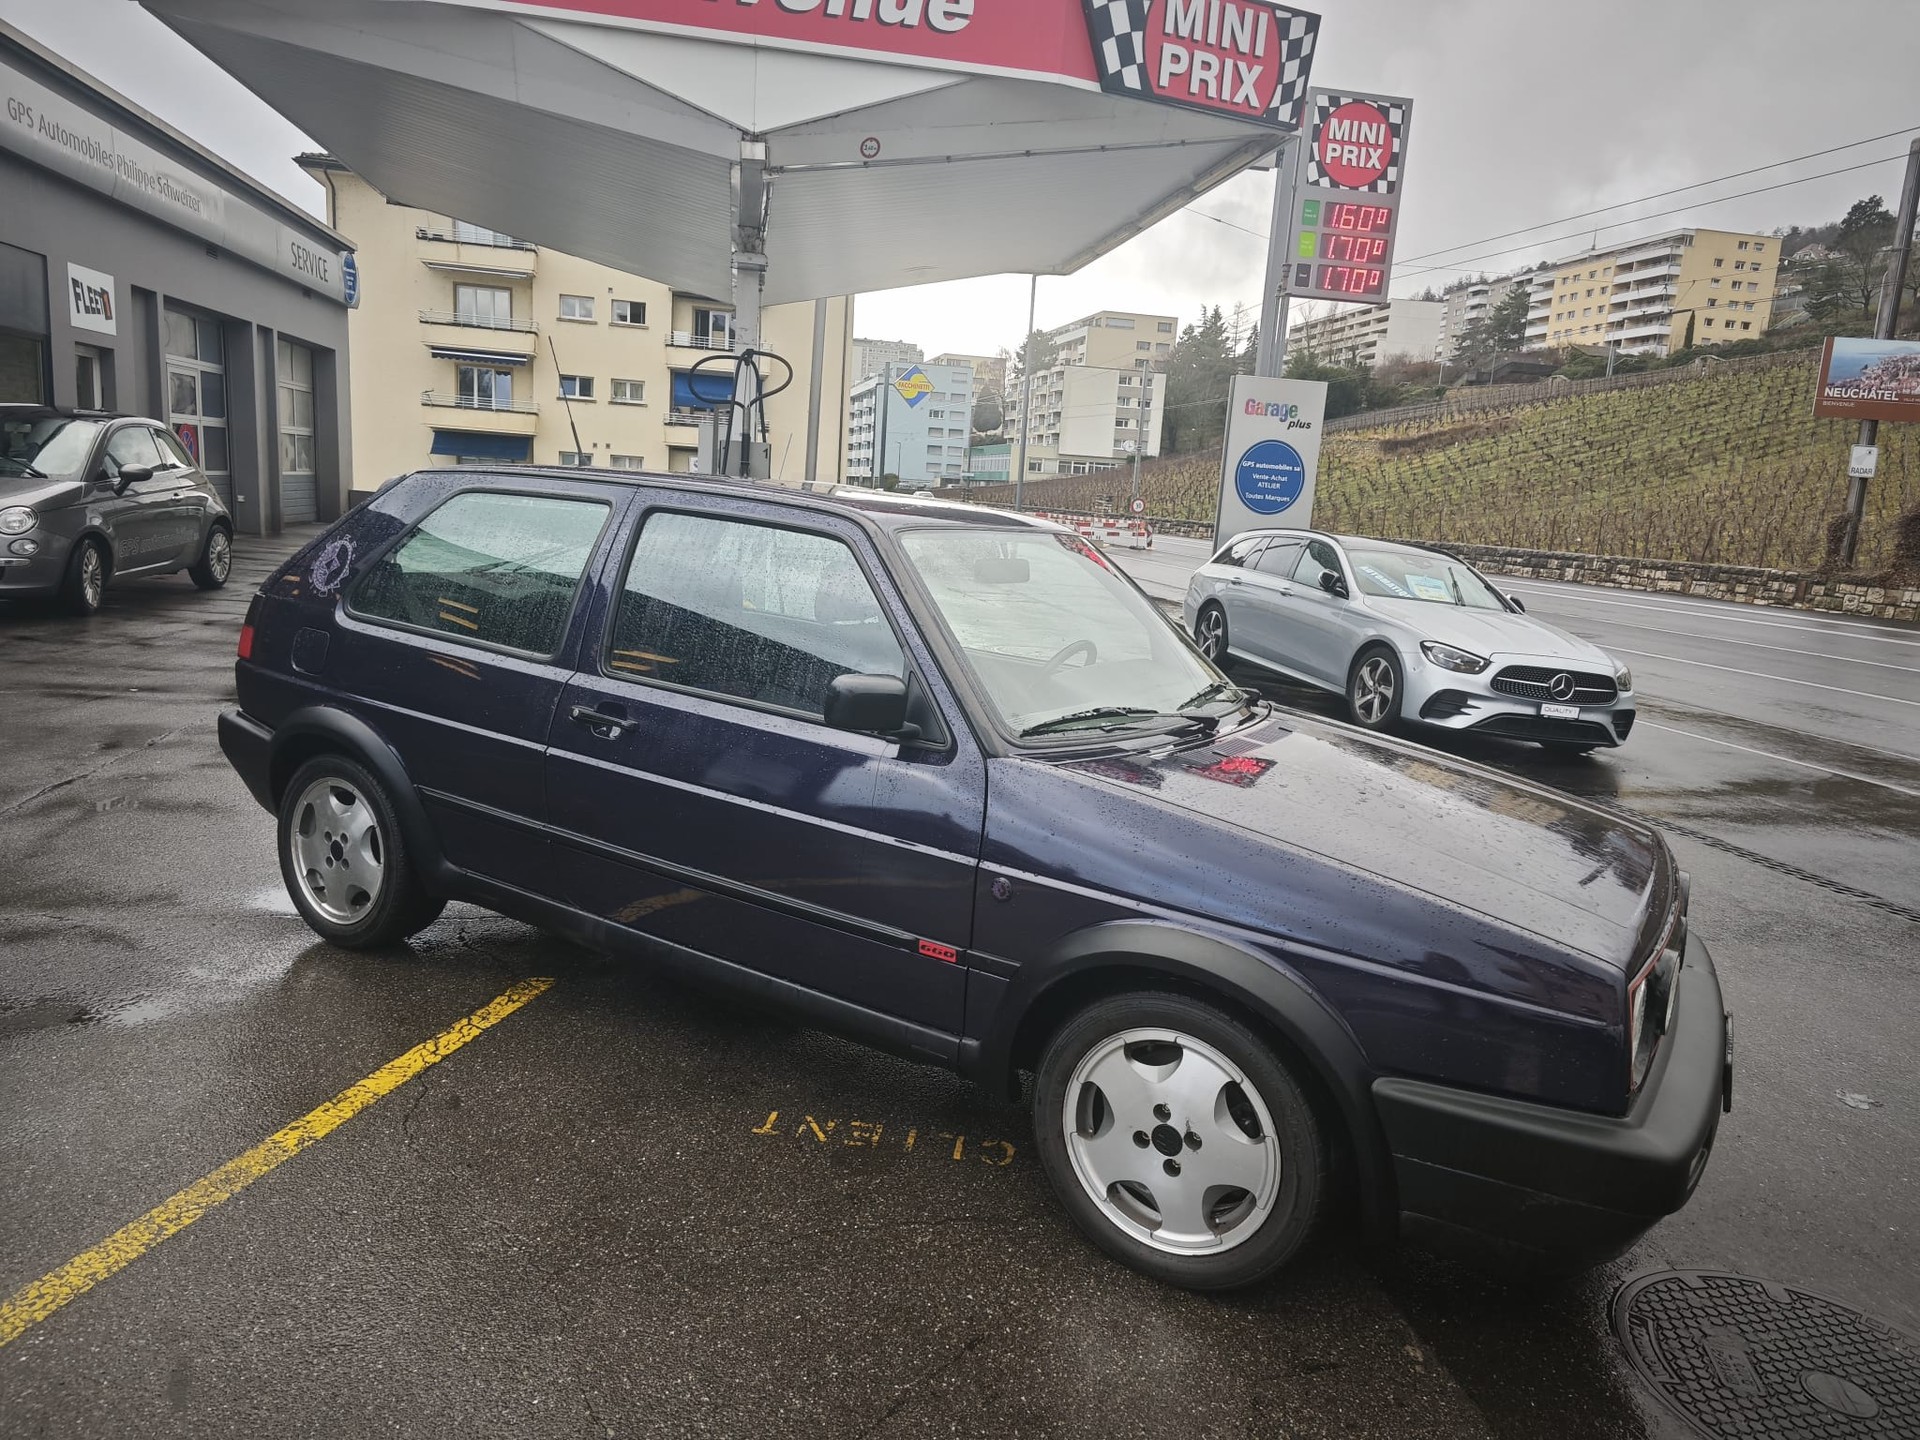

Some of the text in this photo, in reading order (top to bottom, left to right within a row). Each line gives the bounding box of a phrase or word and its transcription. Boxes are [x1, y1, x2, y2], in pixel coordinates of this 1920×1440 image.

[1164, 0, 1269, 57] MINI
[1158, 42, 1264, 108] PRIX
[1328, 117, 1386, 146] MINI
[7, 97, 201, 213] GPS Automobiles Philippe Schweizer
[1325, 143, 1384, 170] PRIX
[290, 241, 329, 283] SERVICE
[1824, 387, 1899, 401] NEUCHÂTEL
[1244, 398, 1299, 422] Garage
[1287, 419, 1312, 430] plus
[1242, 460, 1255, 468] GPS
[1256, 462, 1293, 472] automobiles
[1252, 473, 1288, 483] Vente-Achat
[1851, 466, 1873, 475] RADAR
[1245, 492, 1290, 503] Toutes Marques
[1257, 481, 1281, 490] ATELIER
[751, 1111, 1016, 1166] CLIENT
